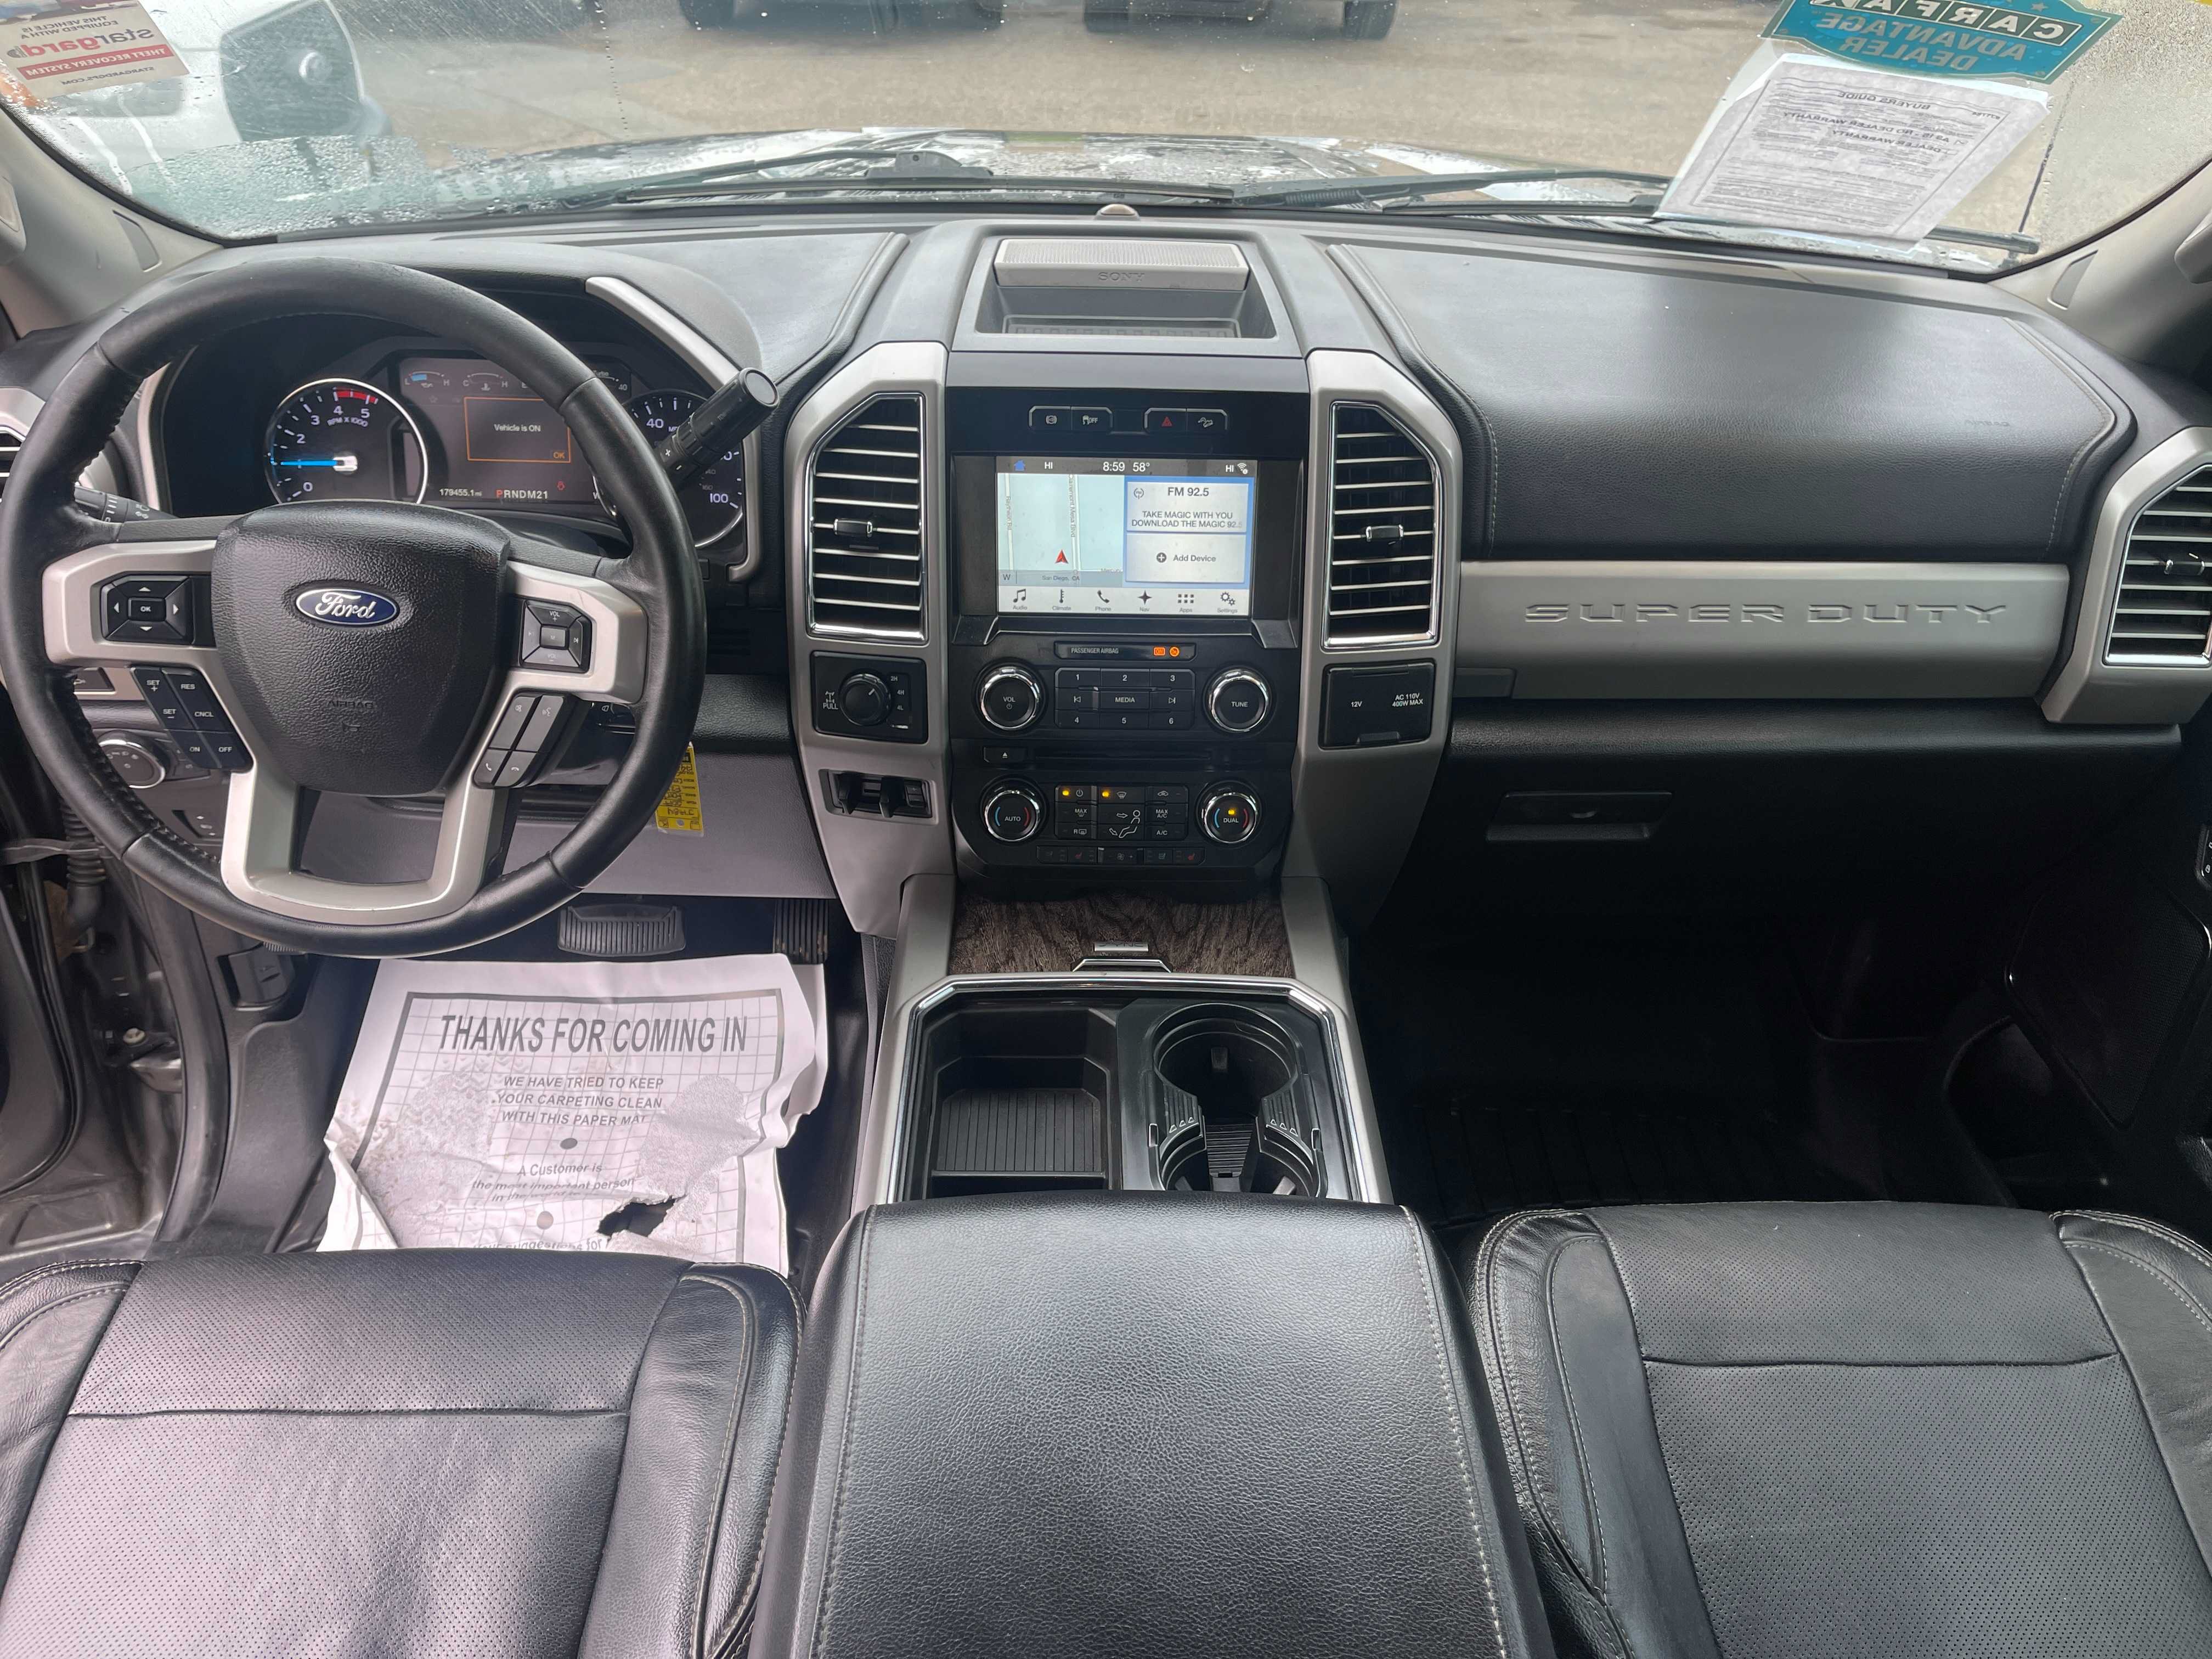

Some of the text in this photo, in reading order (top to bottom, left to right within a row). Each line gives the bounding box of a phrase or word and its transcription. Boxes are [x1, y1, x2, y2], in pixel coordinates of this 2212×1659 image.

[1098, 272, 1146, 282] SONY
[334, 405, 343, 415] 4
[360, 408, 370, 419] 5
[311, 415, 320, 426] 3
[326, 417, 343, 426] RPM
[351, 417, 369, 427] 1000
[646, 419, 664, 428] 40
[494, 424, 541, 433] Vehicle is ON
[296, 434, 306, 444] 2
[1103, 461, 1125, 472] 8:59
[1132, 462, 1150, 472] 58°
[302, 482, 313, 492] 0
[1167, 487, 1210, 496] FM 92.5
[710, 493, 729, 503] 100
[1132, 519, 1179, 527] DOWNLOAD
[315, 592, 377, 621] Ford
[1525, 603, 2007, 624] SUPER DUTY
[823, 702, 839, 710] PULL
[439, 1015, 748, 1053] THANKS FOR COMING IN
[504, 1076, 664, 1090] WE HAVE TRIED TO KEEP
[497, 1093, 663, 1108] YOUR CARPETING CLEAN
[502, 1111, 646, 1126] WITH THIS PAPER MAT
[517, 1164, 602, 1177] A Customer is
[472, 1178, 635, 1194] the most important person
[492, 1193, 504, 1202] in
[507, 1190, 525, 1201] the
[586, 1238, 602, 1251] for
